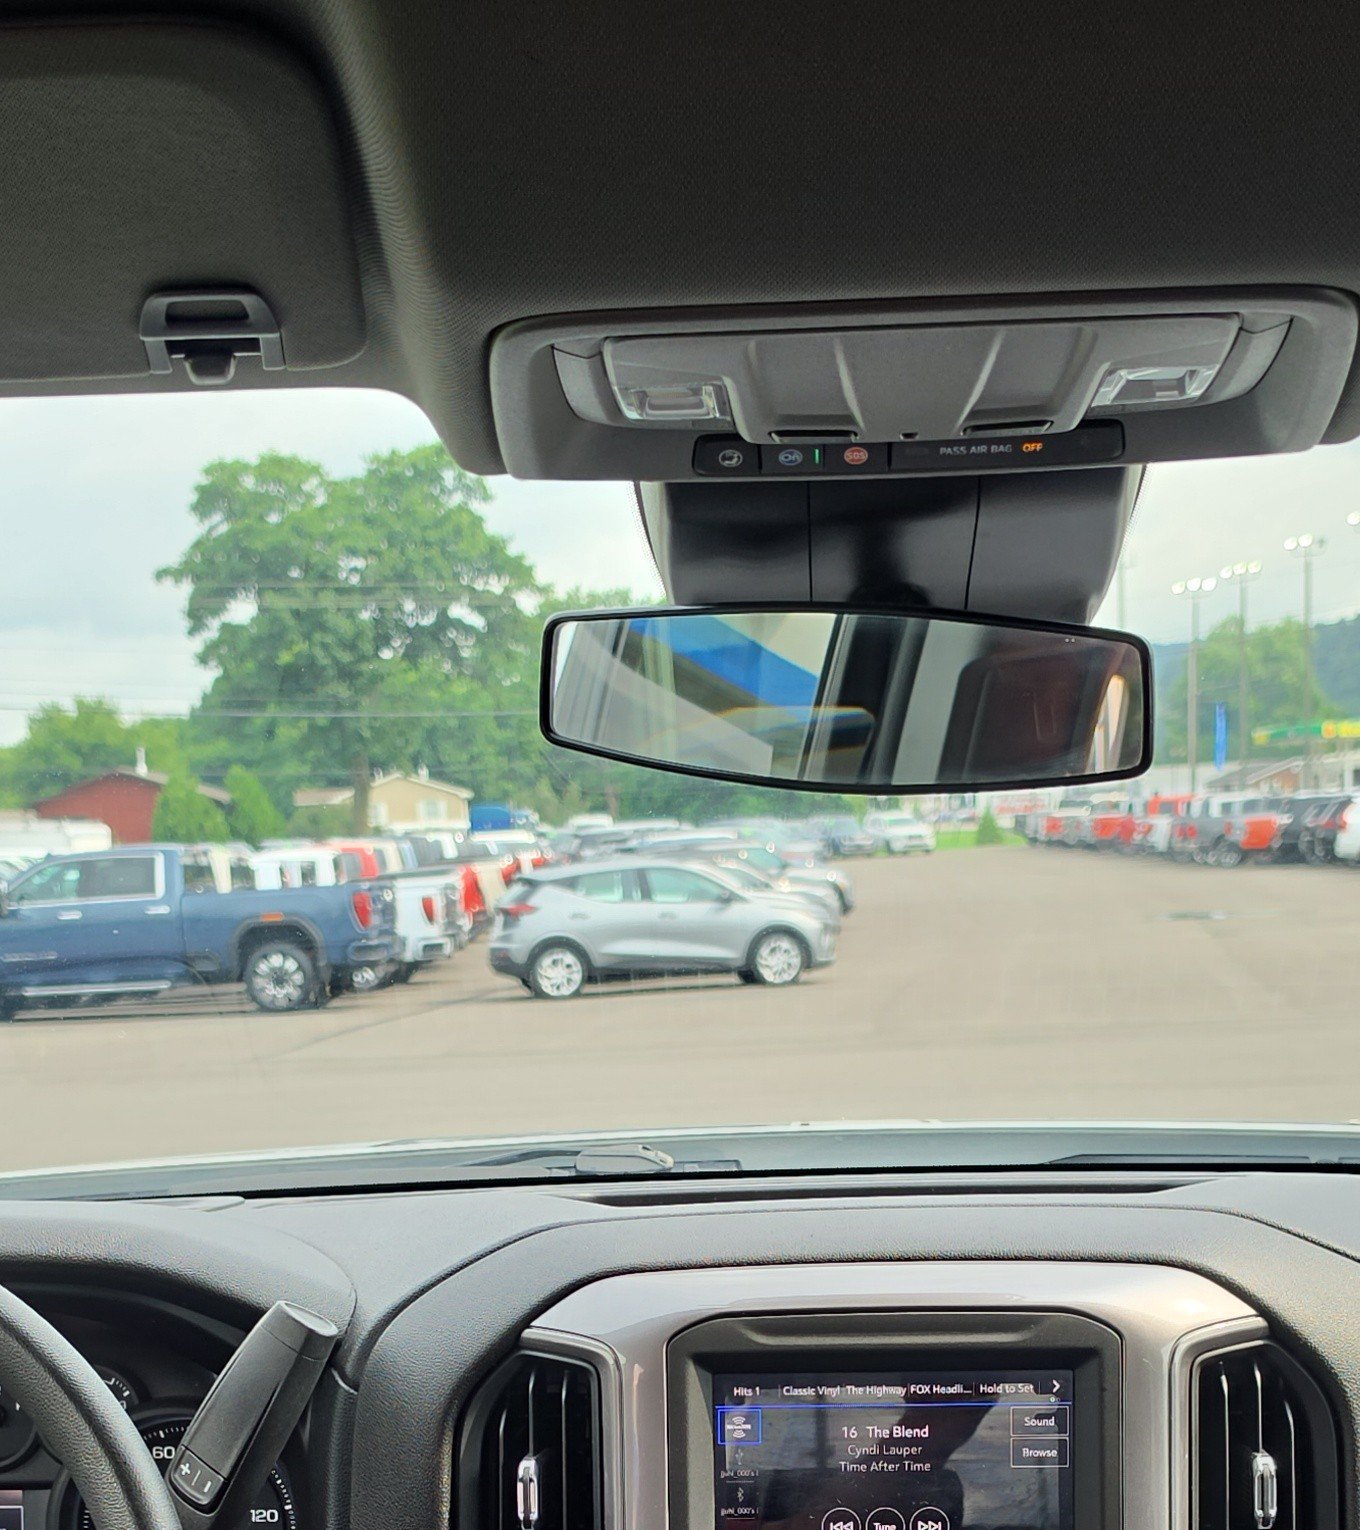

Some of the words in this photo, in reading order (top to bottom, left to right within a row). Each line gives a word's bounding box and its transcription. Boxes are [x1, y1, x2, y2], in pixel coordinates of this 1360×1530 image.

[940, 447, 967, 456] PASS
[970, 446, 988, 455] AIR
[991, 444, 1012, 454] BAG
[1022, 443, 1043, 453] OFF
[846, 450, 866, 461] SOS
[734, 1387, 753, 1396] Hits
[755, 1387, 759, 1395] 1
[783, 1387, 815, 1395] Classic
[817, 1386, 840, 1397] Vinyl
[846, 1385, 863, 1395] The
[865, 1385, 907, 1396] Highway
[911, 1385, 931, 1394] FOX
[980, 1384, 1003, 1393] Hold
[1006, 1385, 1015, 1393] to
[1018, 1384, 1034, 1393] Set
[1024, 1417, 1055, 1426] Sound
[842, 1426, 858, 1438] 16
[866, 1426, 889, 1437] The
[893, 1425, 929, 1437] Blend
[152, 1447, 175, 1459] 60
[848, 1444, 879, 1458] Cyndi
[883, 1445, 922, 1457] Lauper
[1022, 1448, 1057, 1457] Browse
[839, 1461, 867, 1471] Time
[870, 1461, 899, 1471] After
[903, 1461, 931, 1471] Time
[250, 1509, 278, 1522] 120
